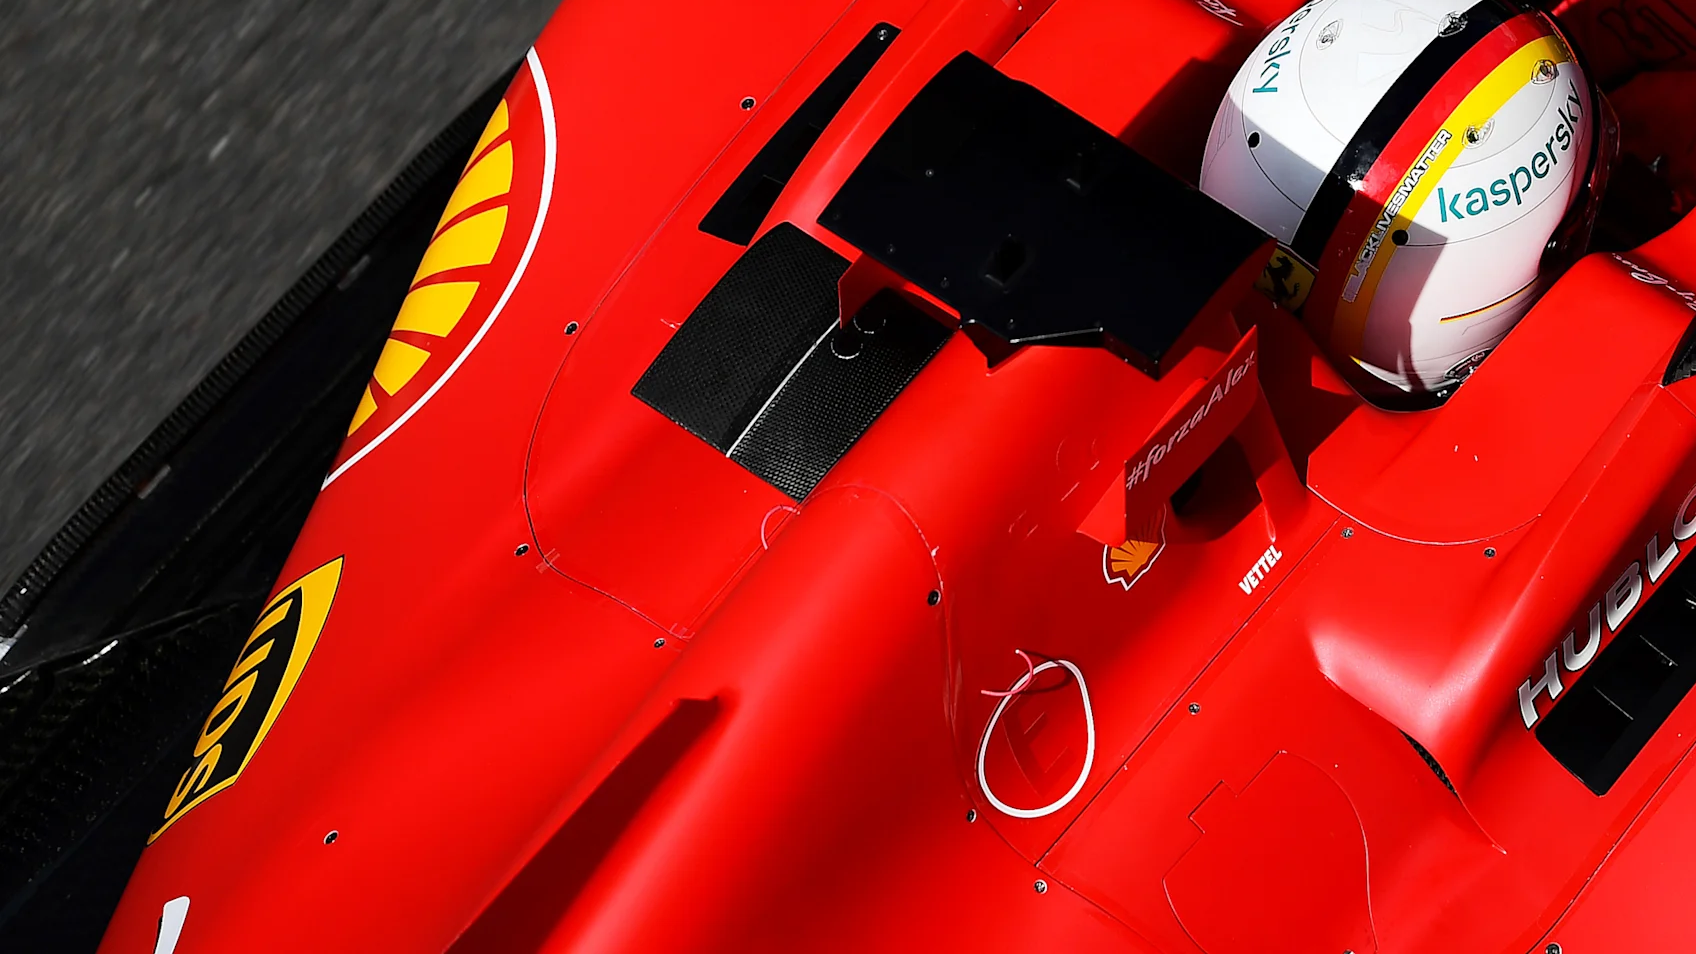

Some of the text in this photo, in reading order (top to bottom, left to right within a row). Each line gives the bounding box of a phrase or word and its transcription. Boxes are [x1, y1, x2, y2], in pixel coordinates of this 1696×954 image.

[1437, 79, 1584, 223] kaspersky
[1126, 350, 1255, 490] #forzaAlex
[1238, 545, 1283, 595] VETTEL
